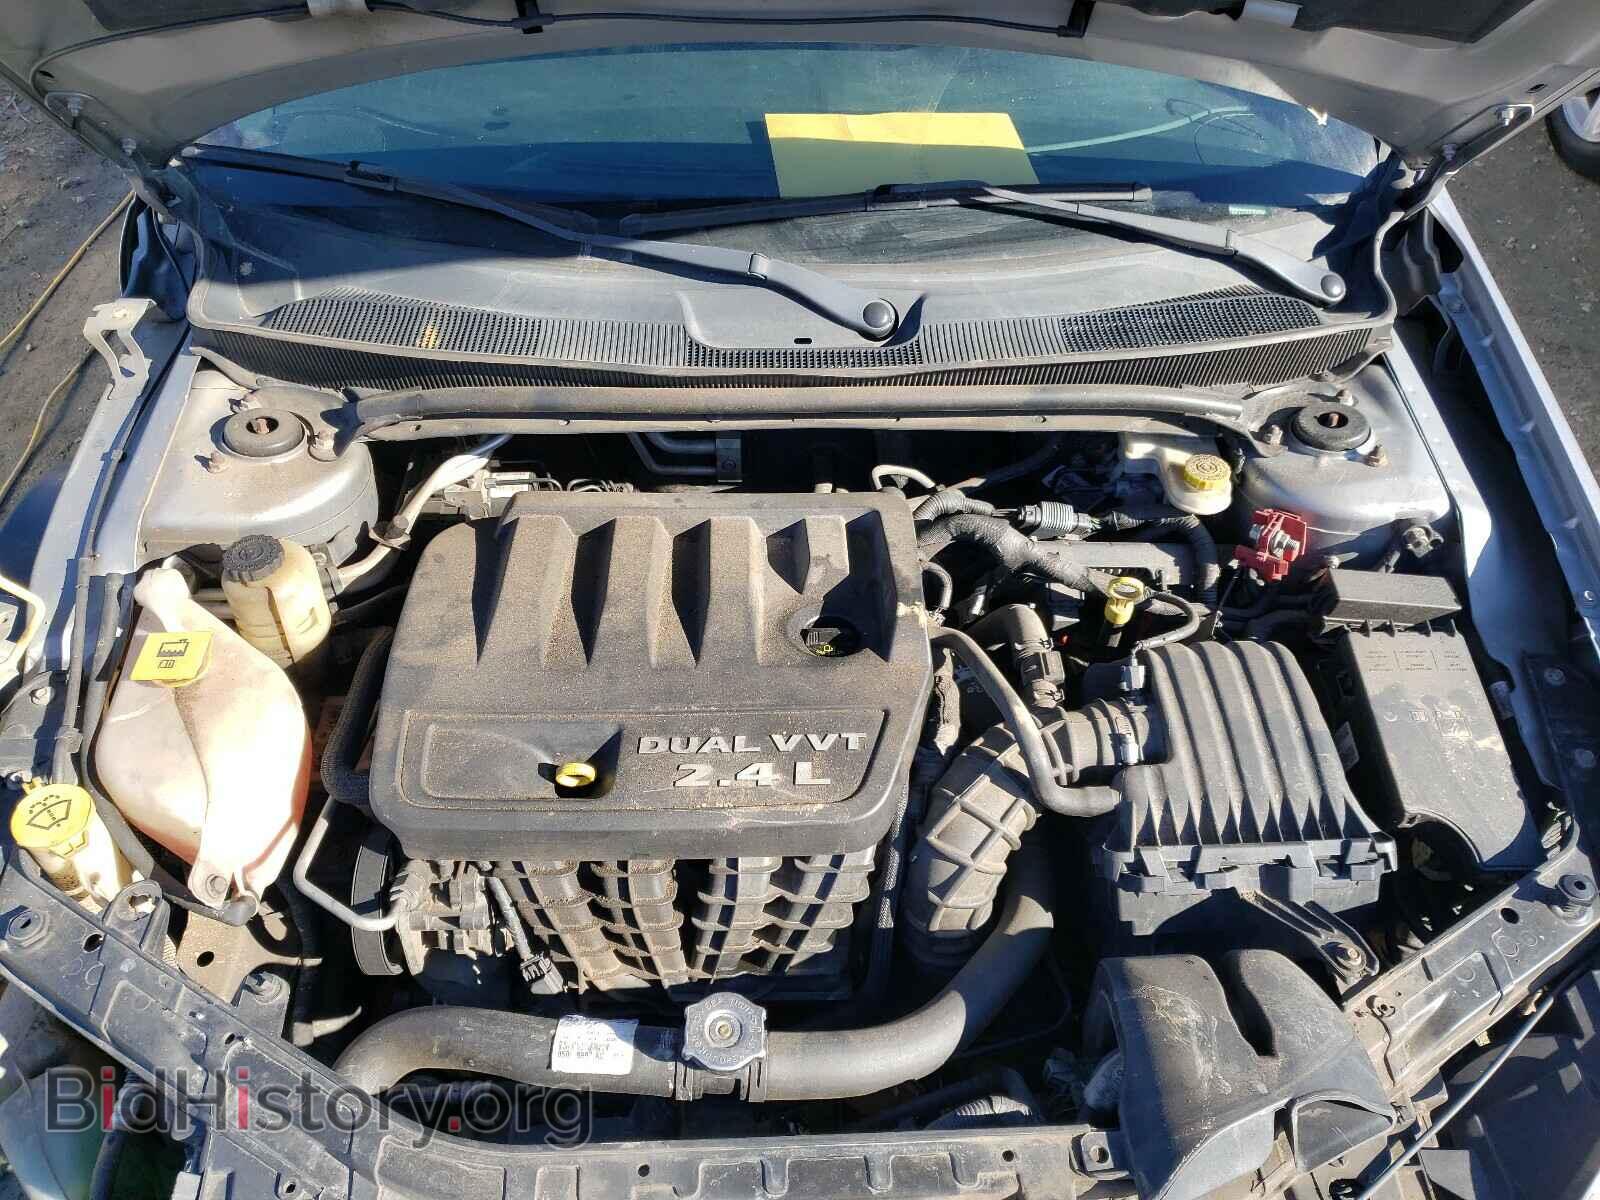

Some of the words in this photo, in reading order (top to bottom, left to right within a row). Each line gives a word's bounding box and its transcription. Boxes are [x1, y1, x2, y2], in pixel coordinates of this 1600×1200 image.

[637, 735, 761, 754] DUAL
[769, 732, 868, 752] VVT
[673, 761, 777, 788] 2.4
[793, 760, 832, 786] L
